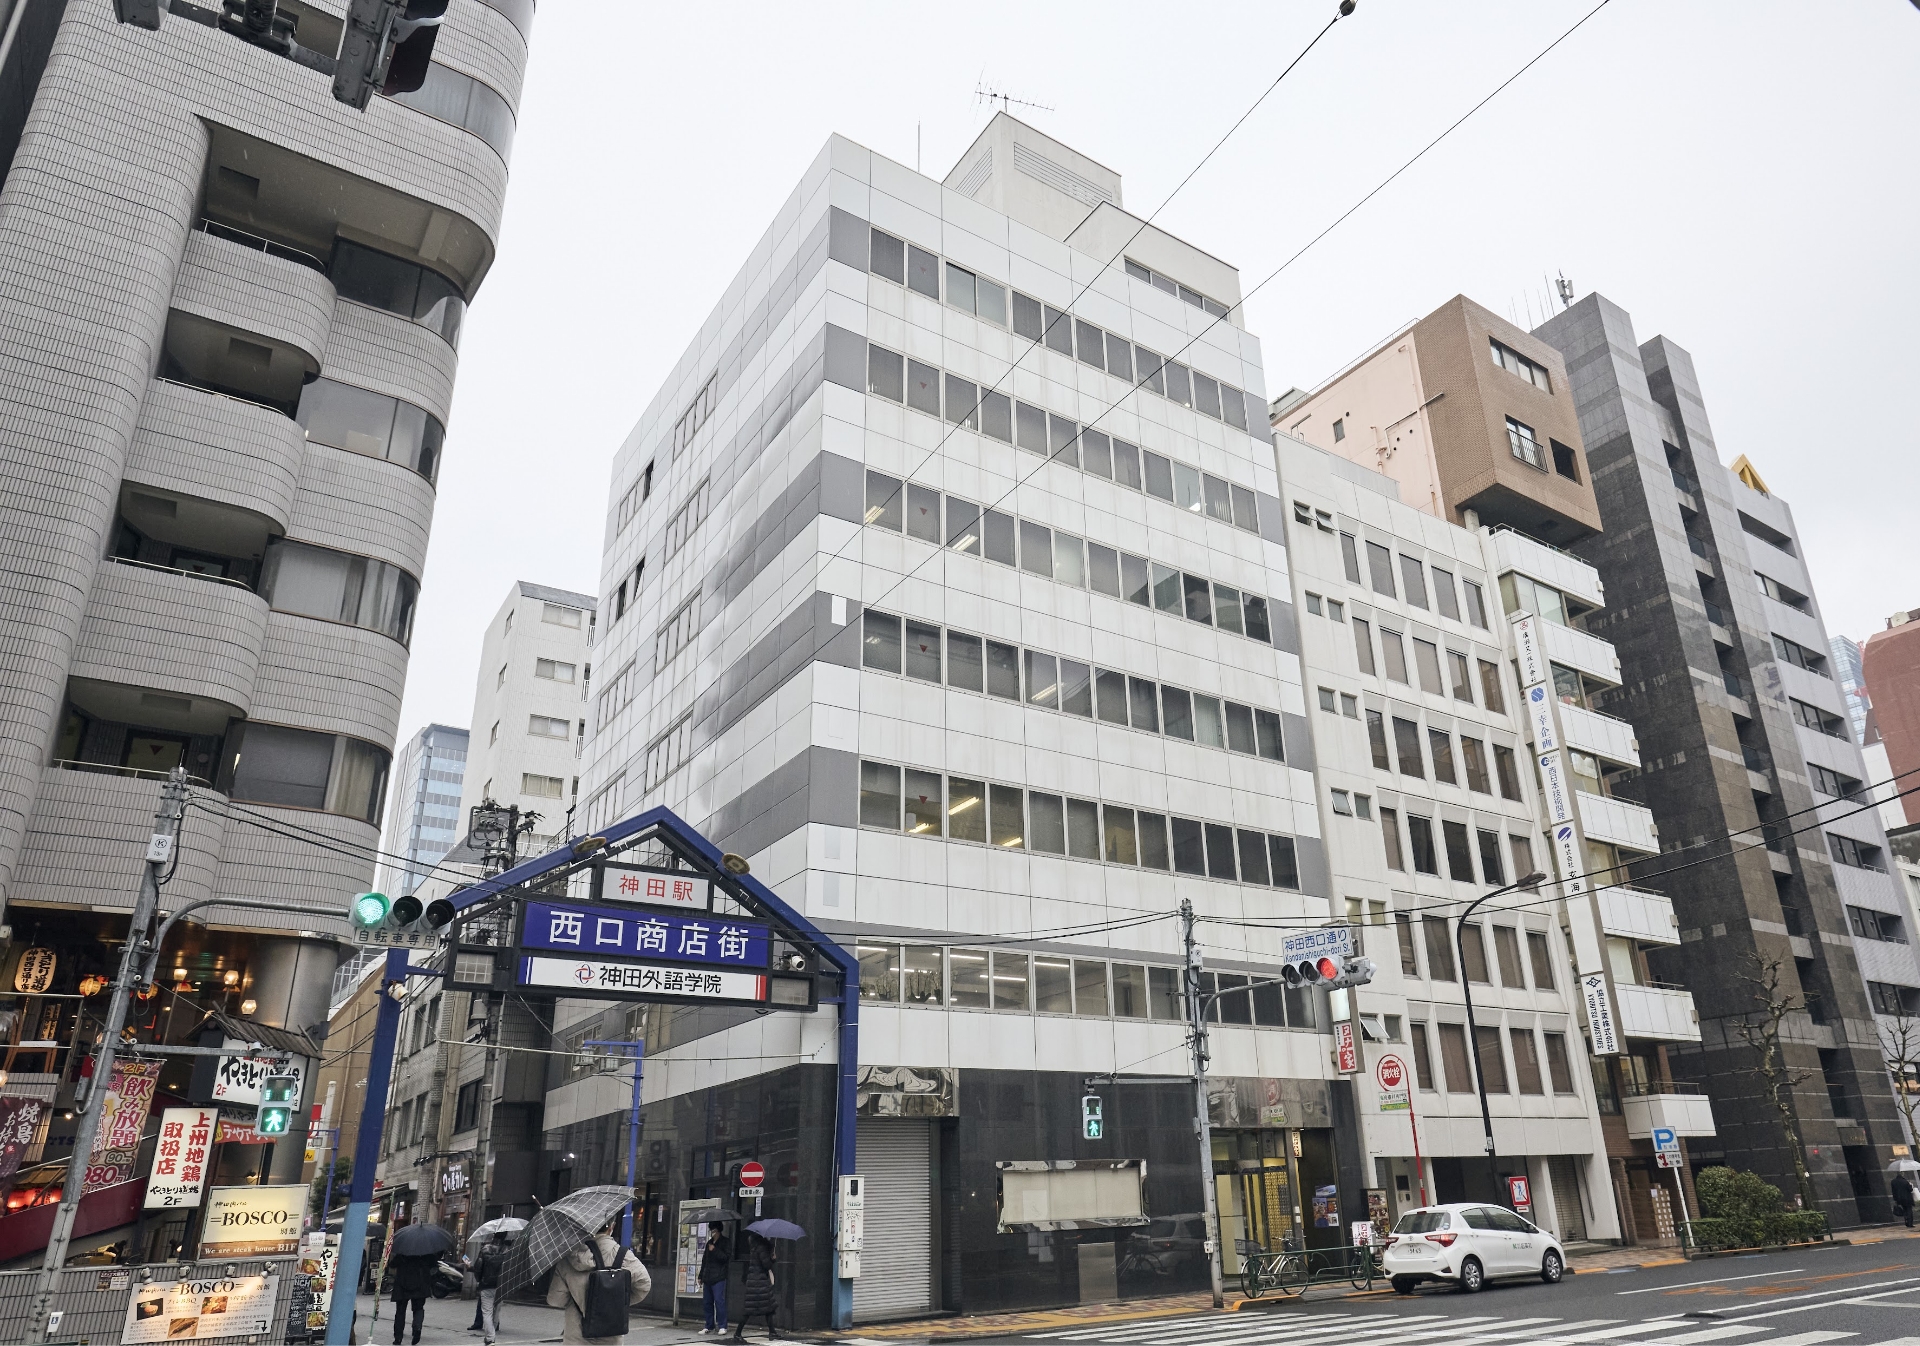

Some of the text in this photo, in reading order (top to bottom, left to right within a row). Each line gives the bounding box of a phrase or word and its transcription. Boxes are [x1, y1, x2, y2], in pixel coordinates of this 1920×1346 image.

[1536, 702, 1553, 749] 三幸企画
[619, 874, 694, 901] 神田駅
[359, 930, 436, 947] 自転車専用
[549, 910, 749, 960] 西口商店街
[1285, 929, 1347, 952] 神田西口通り
[599, 965, 722, 994] 神田外語学院
[123, 1063, 147, 1074] 2F
[1382, 1067, 1401, 1079] 消火栓
[216, 1083, 227, 1096] 2F
[109, 1076, 153, 1148] 飲み放題
[17, 1102, 40, 1145] 焼鳥
[156, 1122, 184, 1175] 取扱店
[180, 1112, 210, 1182] 上州地鶏
[1653, 1129, 1674, 1150] P
[150, 1185, 199, 1195] やきとり道場
[163, 1196, 182, 1206] 2F
[221, 1210, 288, 1226] BOSCO
[180, 1281, 235, 1296] BOSCO
